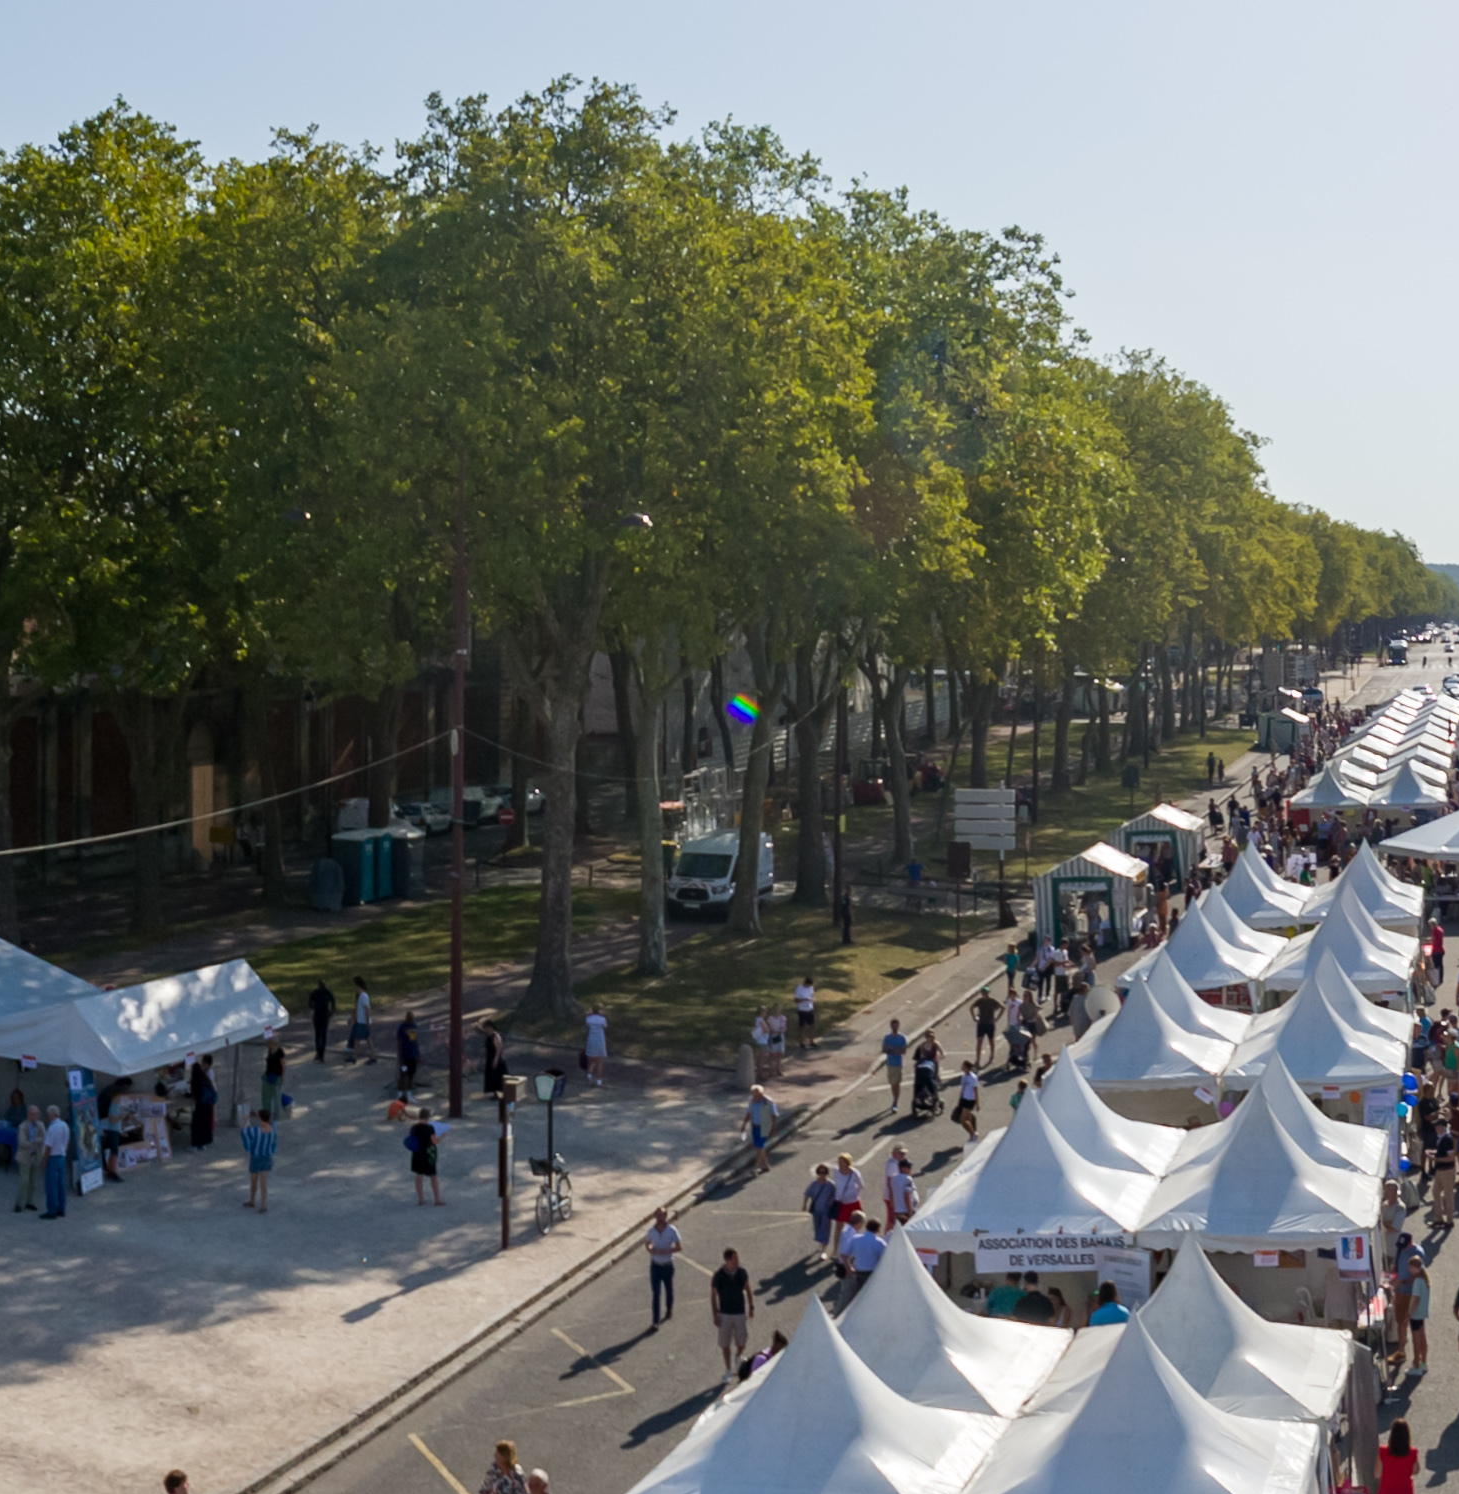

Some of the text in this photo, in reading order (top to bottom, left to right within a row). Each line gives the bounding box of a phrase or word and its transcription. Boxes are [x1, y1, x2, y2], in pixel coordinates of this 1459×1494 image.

[979, 1239, 1052, 1250] ASSOCIATION
[1055, 1238, 1076, 1249] DES
[1010, 1255, 1025, 1266] DE
[1028, 1254, 1095, 1265] VERSAILLES
